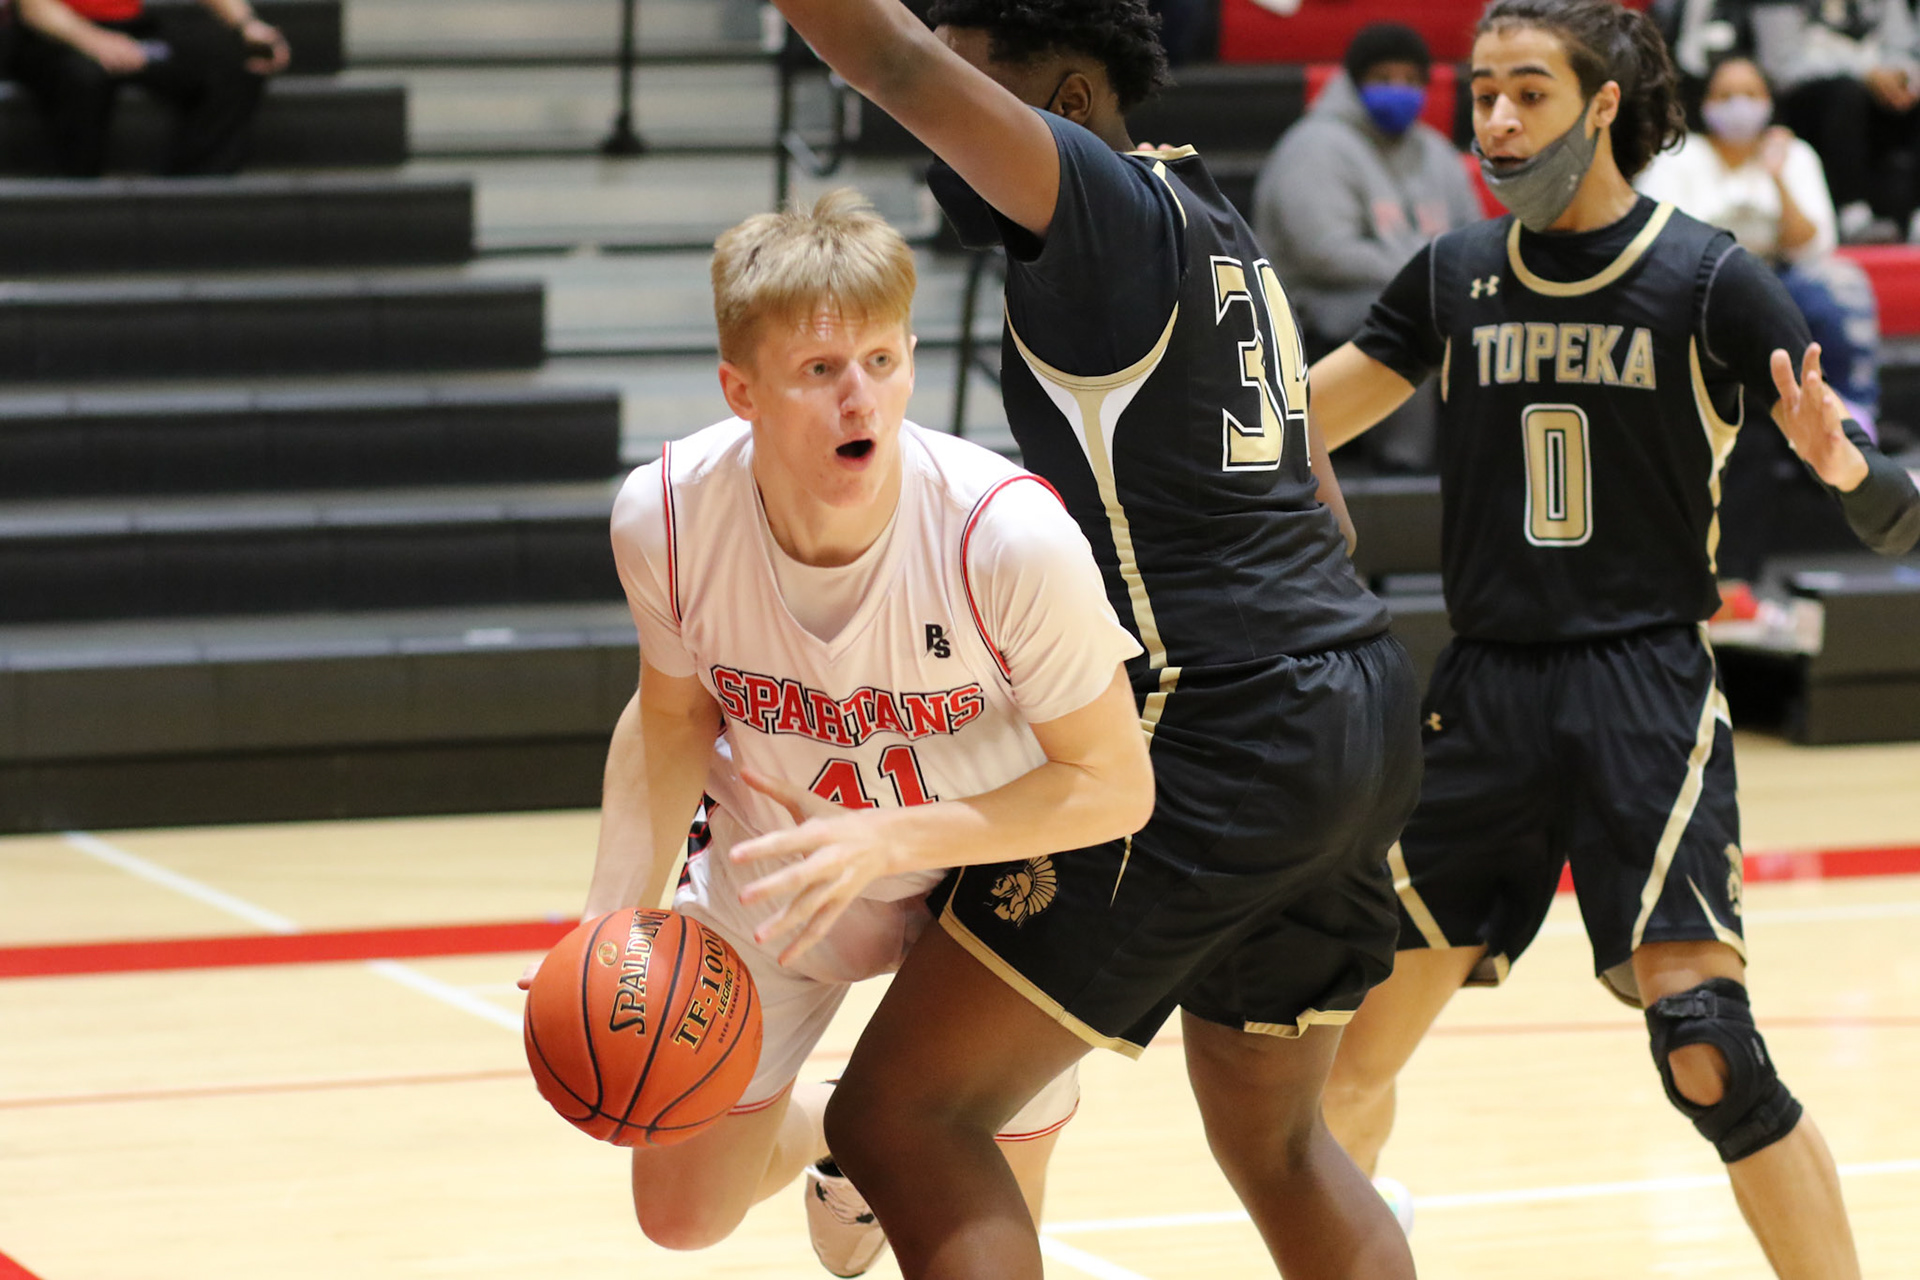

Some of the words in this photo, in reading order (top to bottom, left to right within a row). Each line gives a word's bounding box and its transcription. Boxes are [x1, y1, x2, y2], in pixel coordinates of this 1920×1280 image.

[1210, 255, 1311, 472] 34
[1472, 322, 1656, 390] TOPEKA
[1521, 404, 1592, 547] 0
[710, 664, 984, 747] SPARTANS
[808, 744, 938, 808] 41
[609, 909, 672, 1037] SPALDING
[715, 966, 735, 1017] LEGACY
